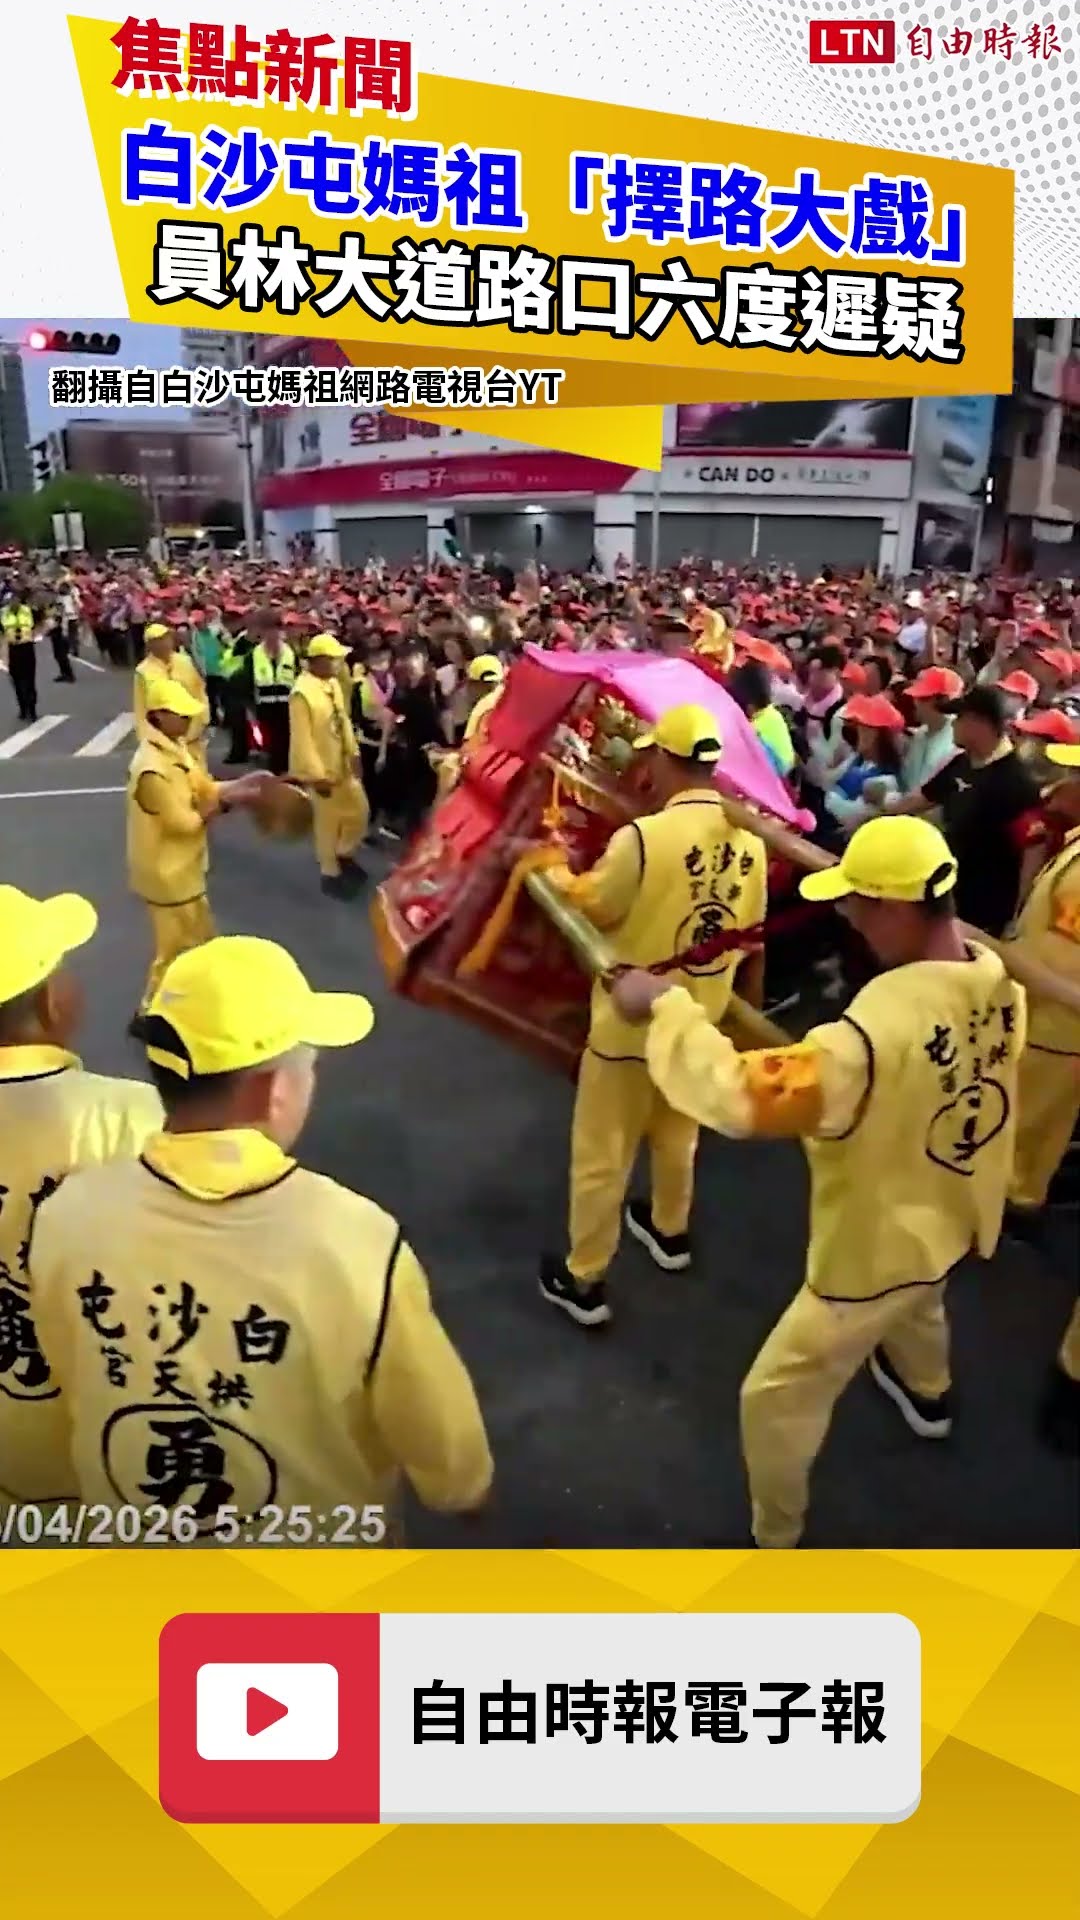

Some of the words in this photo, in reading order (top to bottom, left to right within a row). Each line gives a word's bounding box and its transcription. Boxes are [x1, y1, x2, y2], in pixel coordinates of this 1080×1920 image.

[699, 466, 738, 482] CAN
[746, 467, 775, 483] DO
[138, 1418, 234, 1518] 勇
